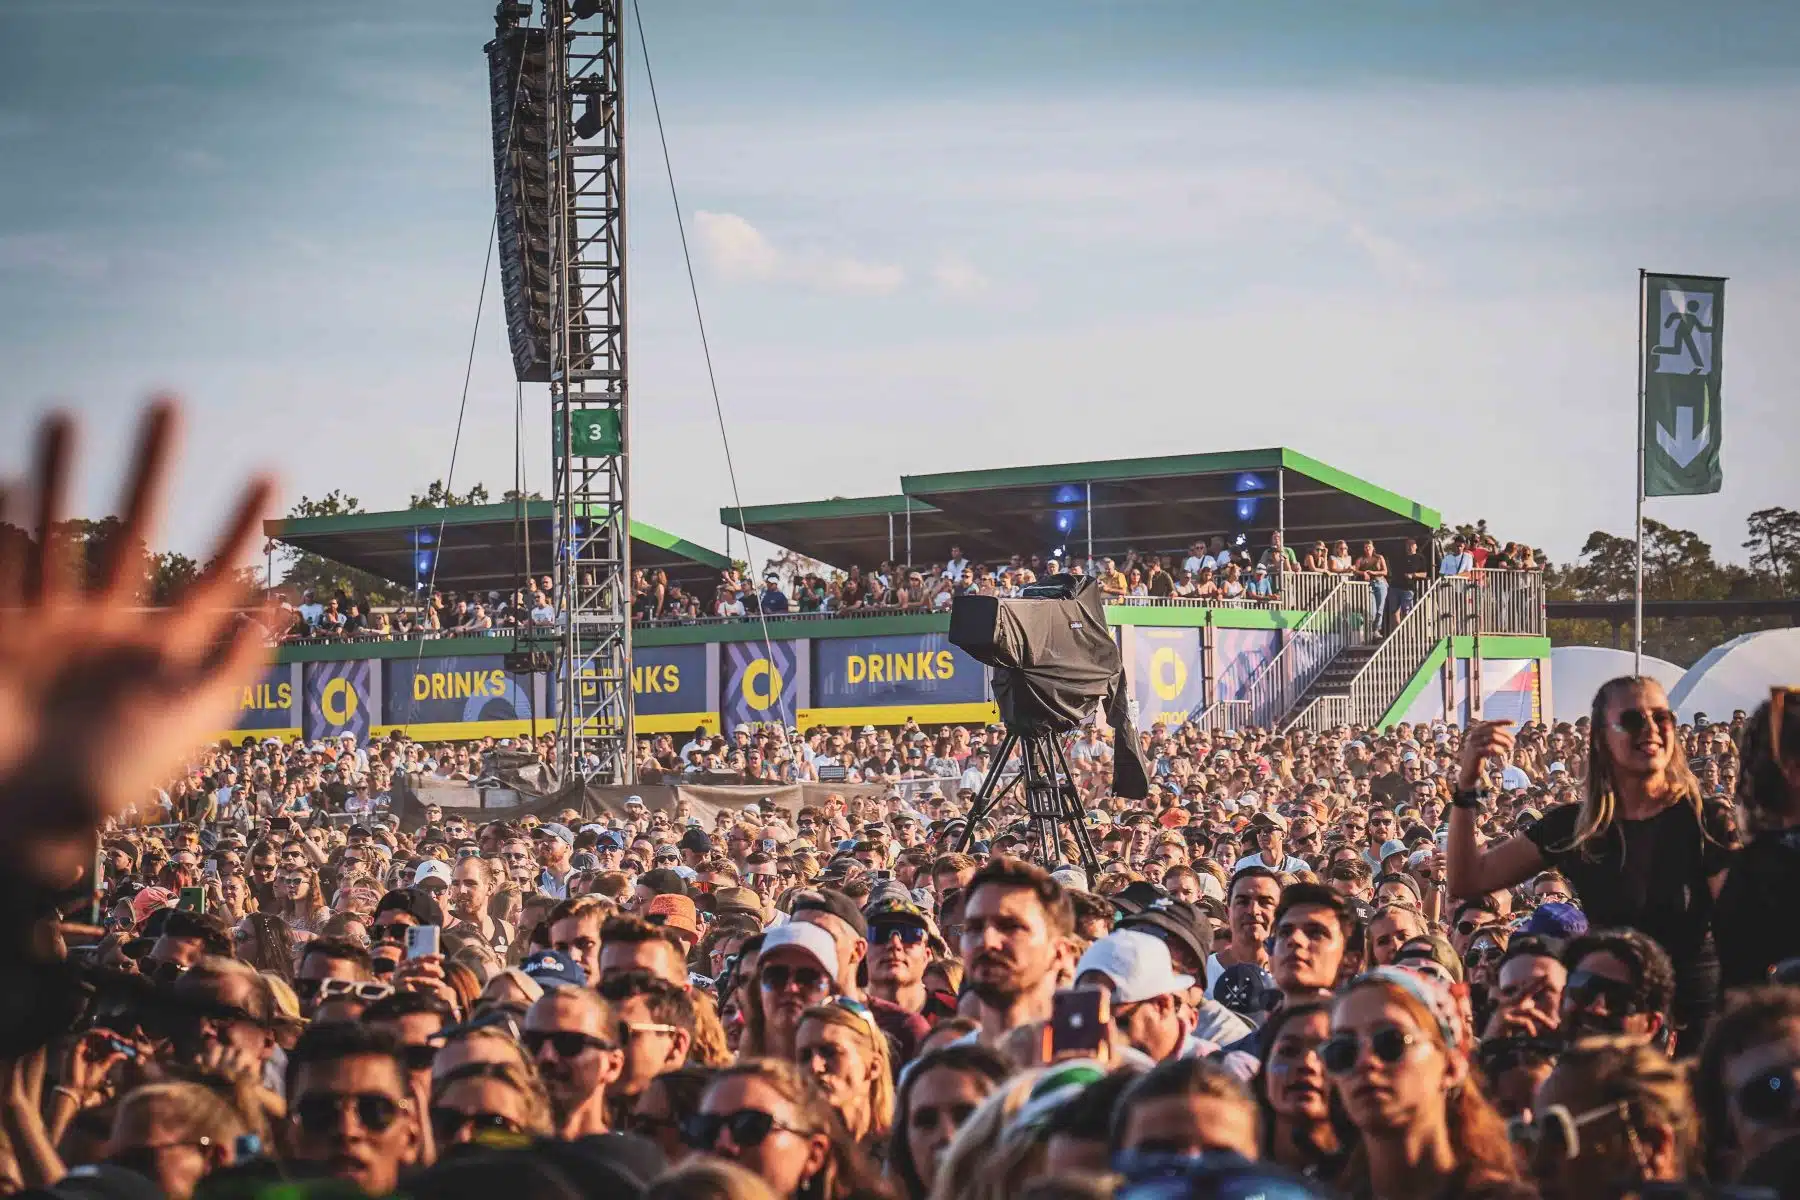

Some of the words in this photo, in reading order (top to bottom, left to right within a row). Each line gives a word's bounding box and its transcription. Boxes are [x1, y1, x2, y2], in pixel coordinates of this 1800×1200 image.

[588, 423, 602, 441] 3
[582, 664, 680, 696] DRNKS
[847, 650, 955, 684] DRINKS
[414, 669, 506, 701] DRINKS
